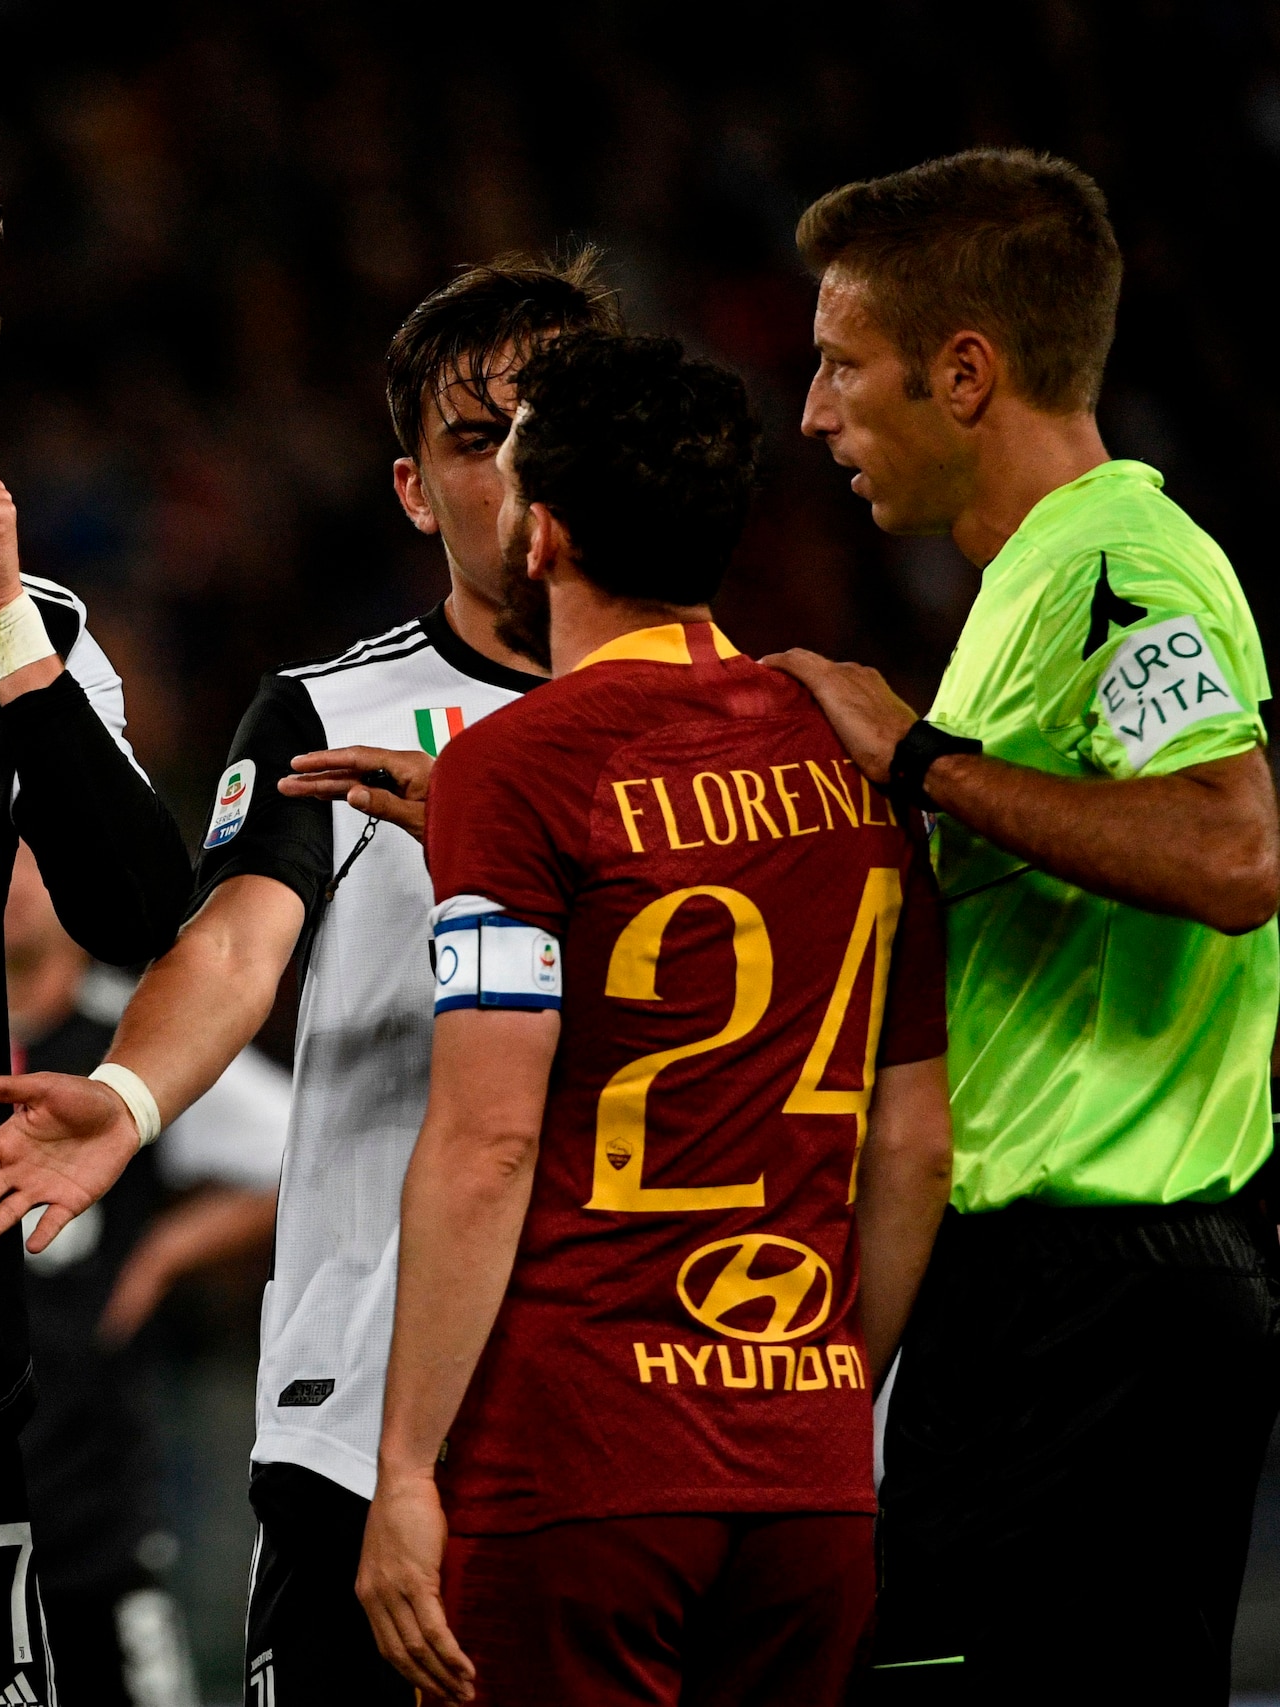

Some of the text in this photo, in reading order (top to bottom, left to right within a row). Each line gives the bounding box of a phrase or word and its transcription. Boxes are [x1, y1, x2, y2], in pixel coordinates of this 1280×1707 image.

[1102, 632, 1202, 713] EURO
[1119, 672, 1229, 742] VITA
[219, 822, 239, 839] TIM
[582, 867, 904, 1213] 24
[633, 1342, 866, 1391] HYUNDAI
